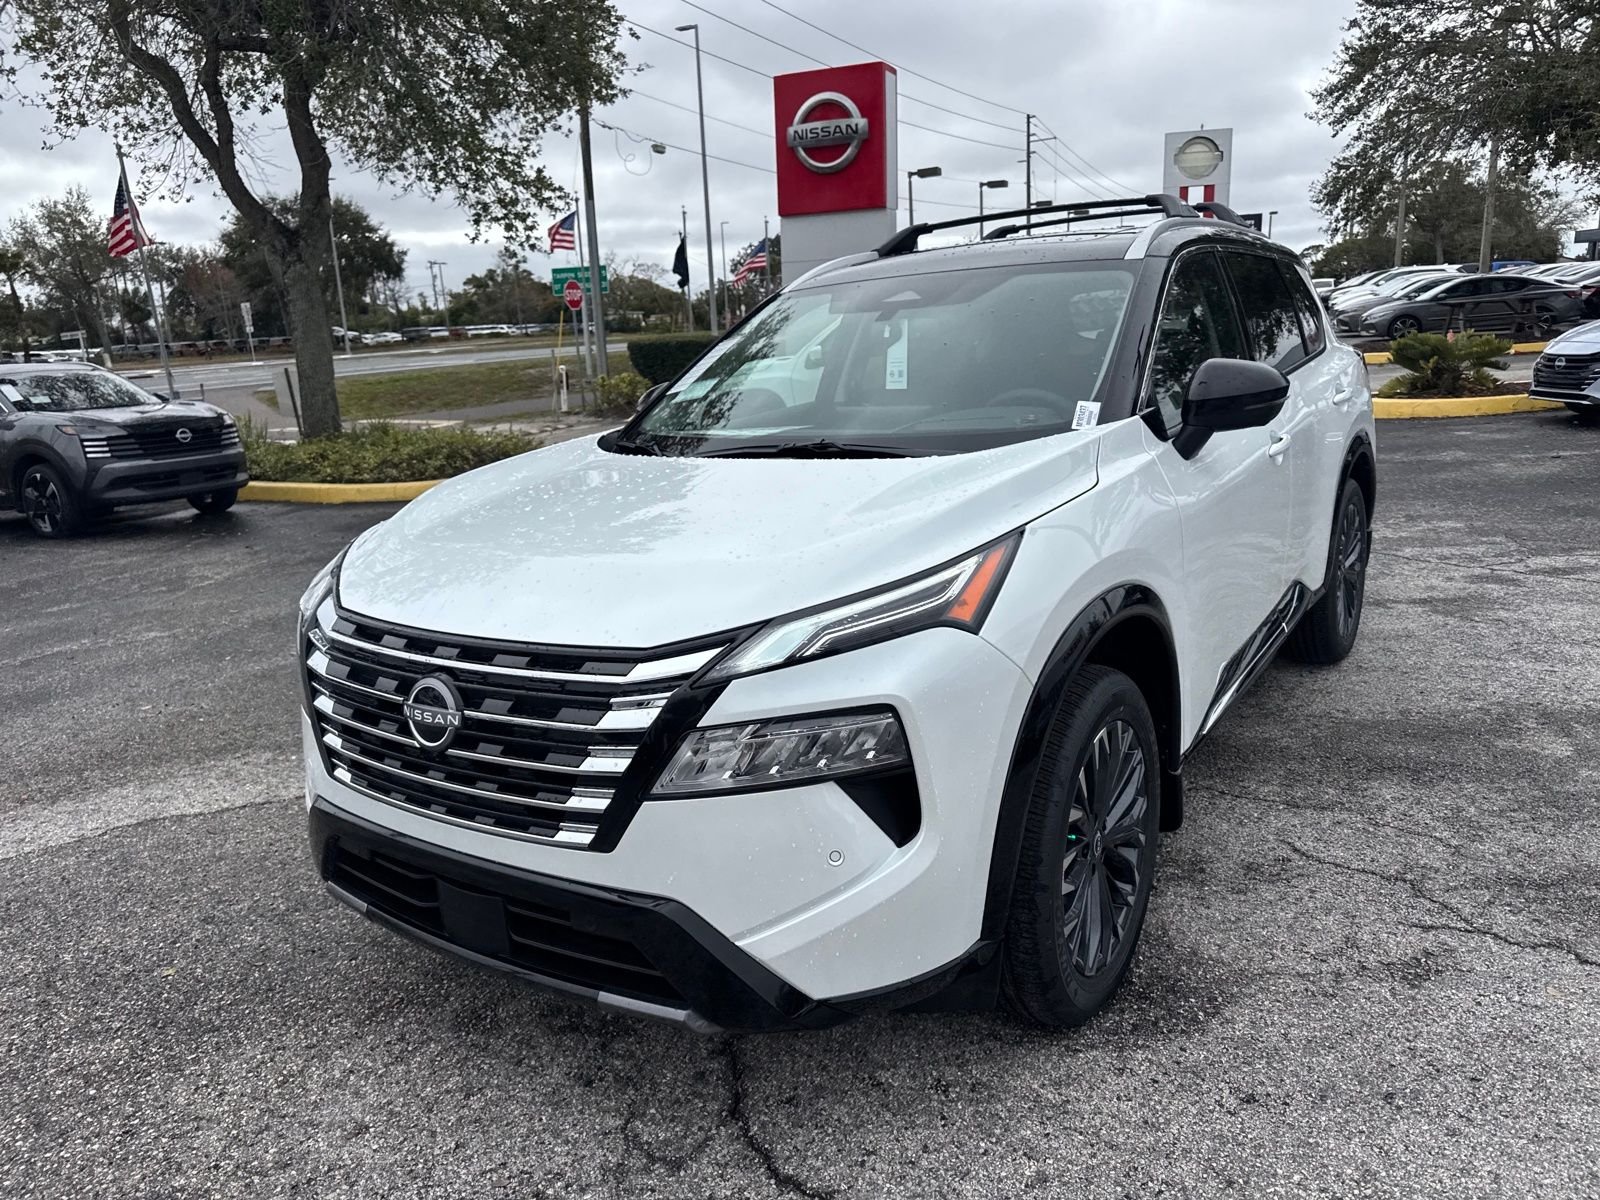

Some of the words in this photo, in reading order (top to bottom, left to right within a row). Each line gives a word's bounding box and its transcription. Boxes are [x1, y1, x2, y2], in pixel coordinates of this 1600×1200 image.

[793, 123, 859, 141] NISSAN
[566, 289, 582, 301] STOP
[404, 704, 459, 725] NISSAN
